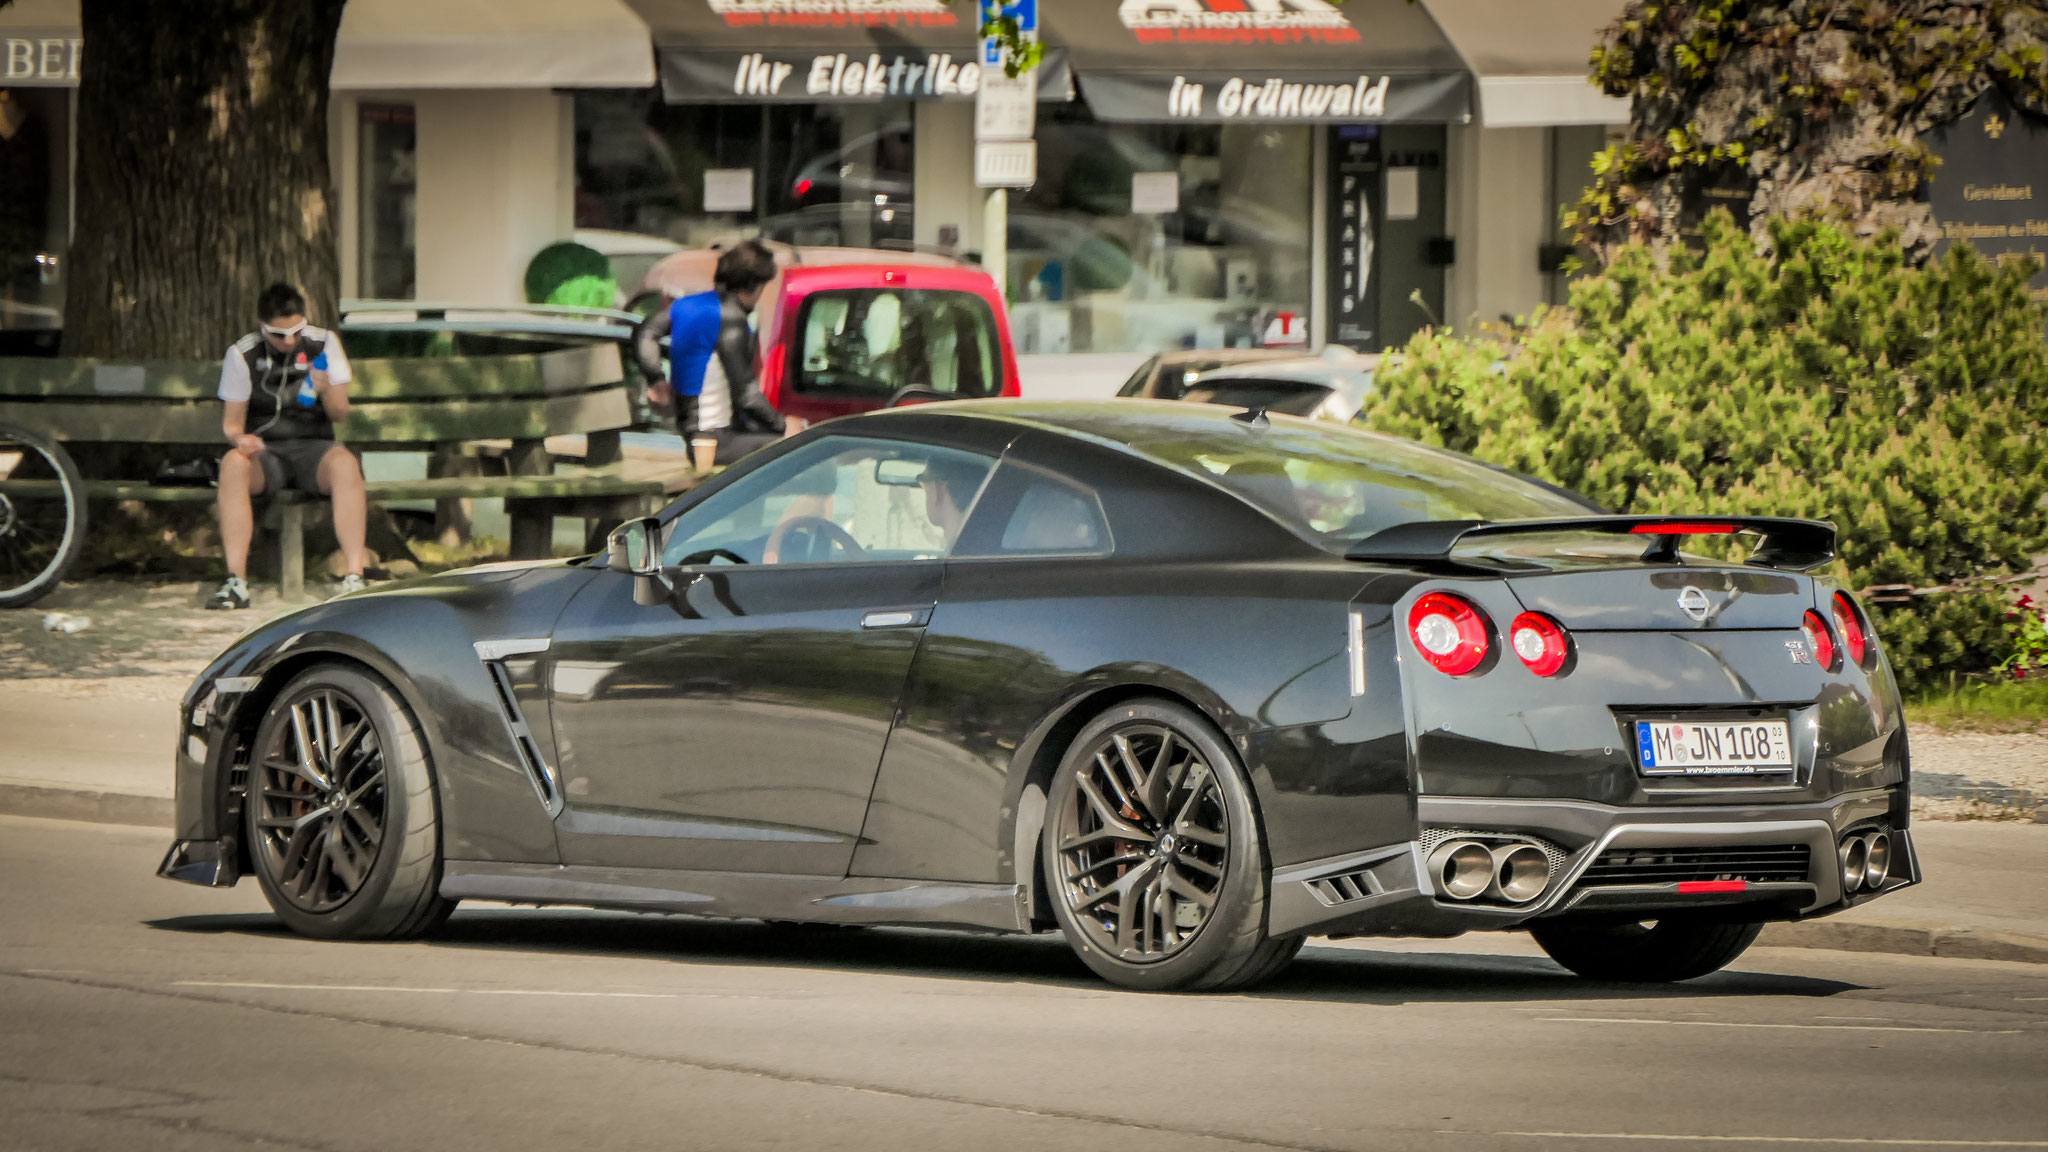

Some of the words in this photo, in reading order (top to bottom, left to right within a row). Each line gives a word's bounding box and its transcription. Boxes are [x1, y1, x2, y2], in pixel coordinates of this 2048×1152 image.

[733, 53, 793, 96] Ihr
[806, 53, 980, 96] Elektrike
[1168, 75, 1203, 117] in
[1216, 75, 1390, 117] Grünwald
[1772, 726, 1783, 737] 03
[1644, 749, 1652, 761] D
[1655, 727, 1673, 761] M
[1691, 726, 1722, 761] JN
[1725, 726, 1771, 760] 108
[1776, 750, 1786, 761] 10
